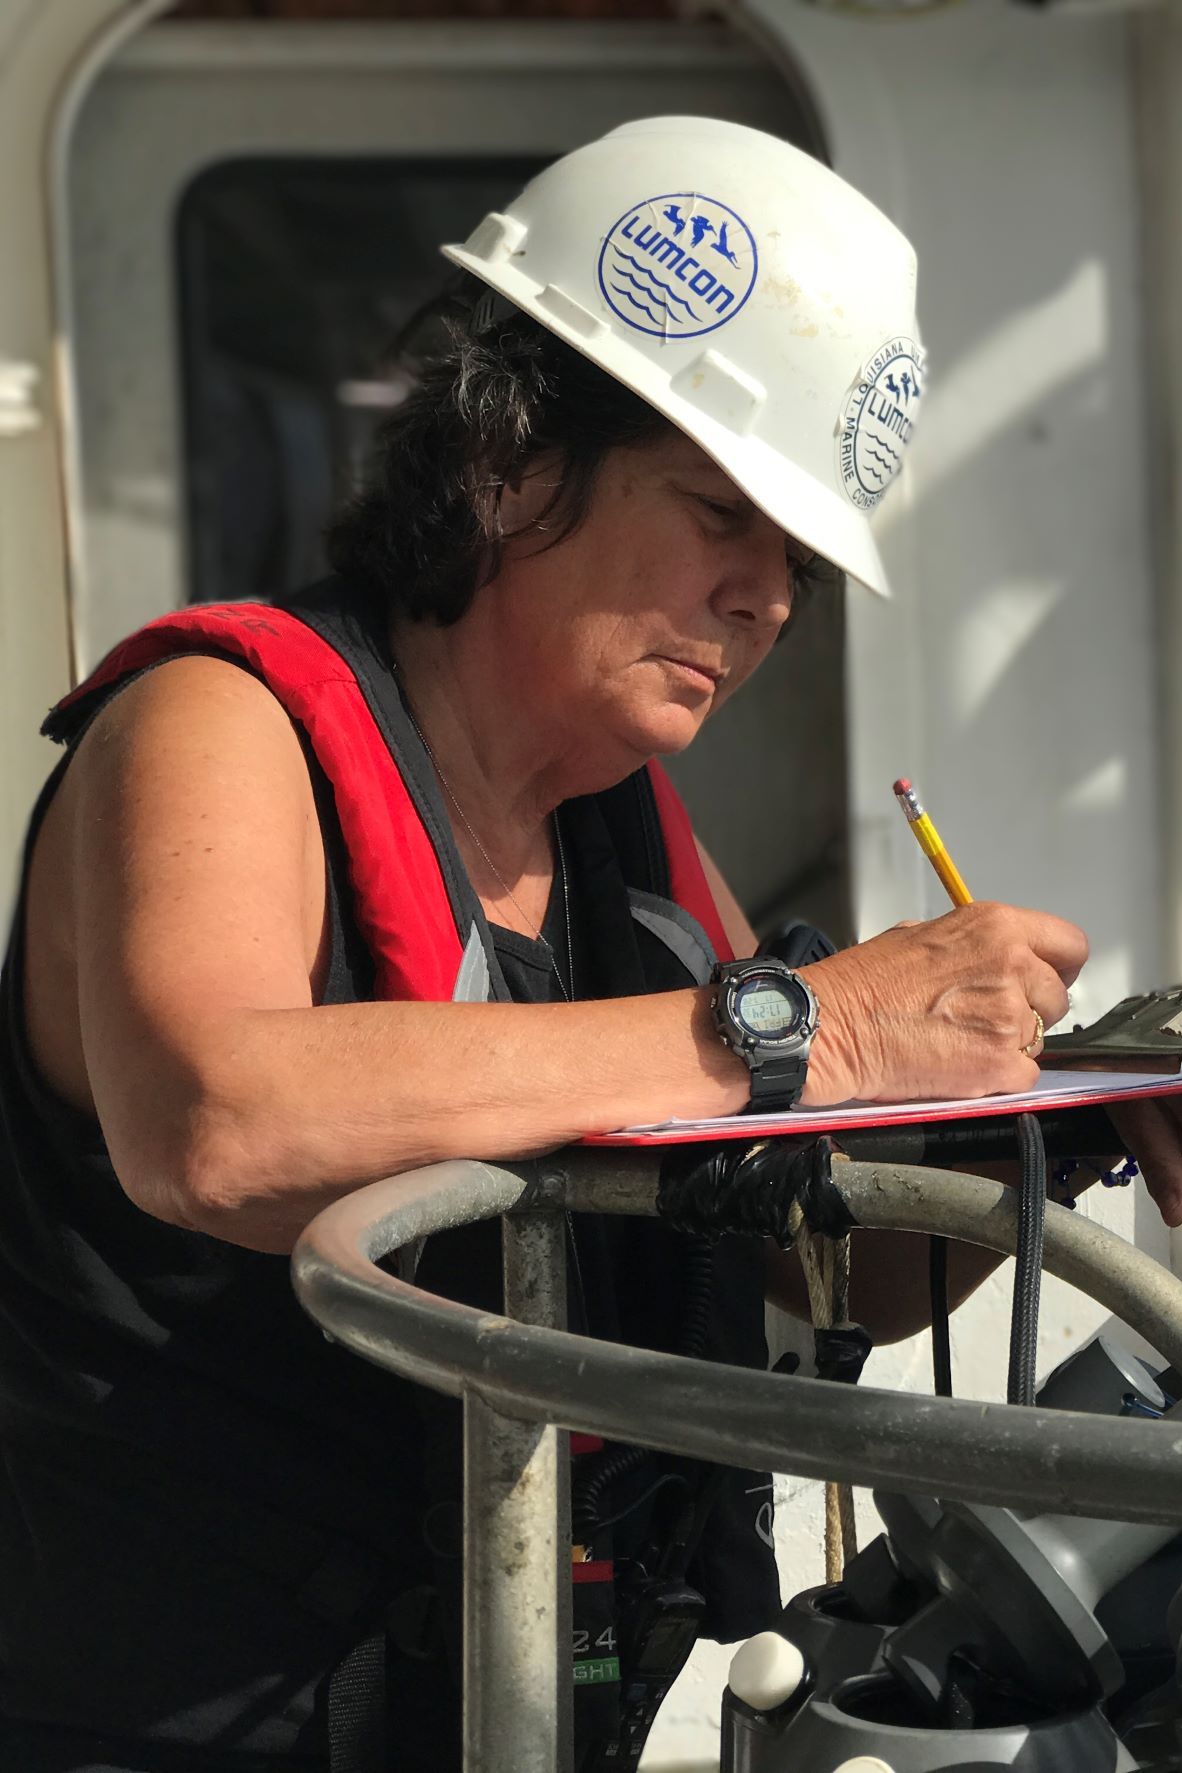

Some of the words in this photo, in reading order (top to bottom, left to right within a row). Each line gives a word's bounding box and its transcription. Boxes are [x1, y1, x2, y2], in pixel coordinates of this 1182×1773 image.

[621, 215, 735, 314] LUMCON
[852, 341, 904, 406] LOUISIANA
[841, 416, 856, 483] MARINE
